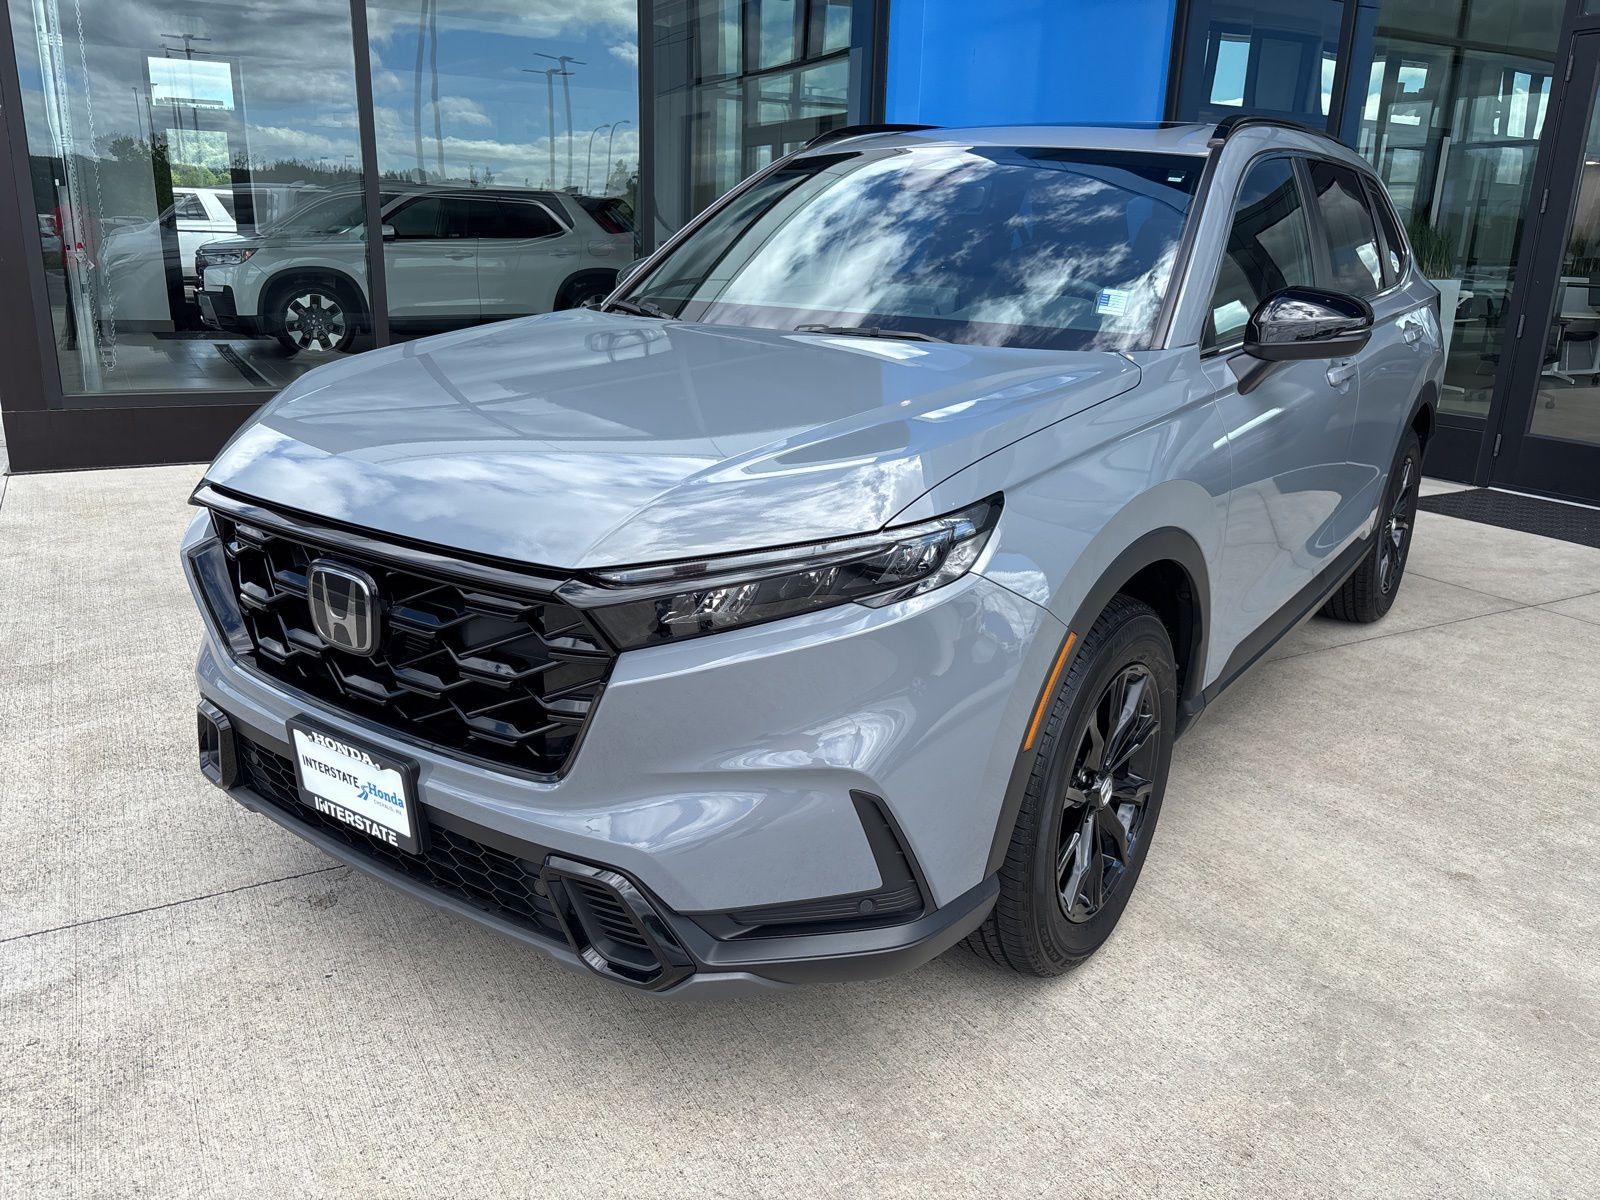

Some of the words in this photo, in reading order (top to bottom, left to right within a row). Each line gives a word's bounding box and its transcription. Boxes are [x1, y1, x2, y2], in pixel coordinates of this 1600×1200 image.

[311, 731, 375, 766] HONDA
[302, 754, 360, 789] INTERSTATE
[367, 782, 404, 808] Honda
[314, 796, 399, 847] INTERSTATE
